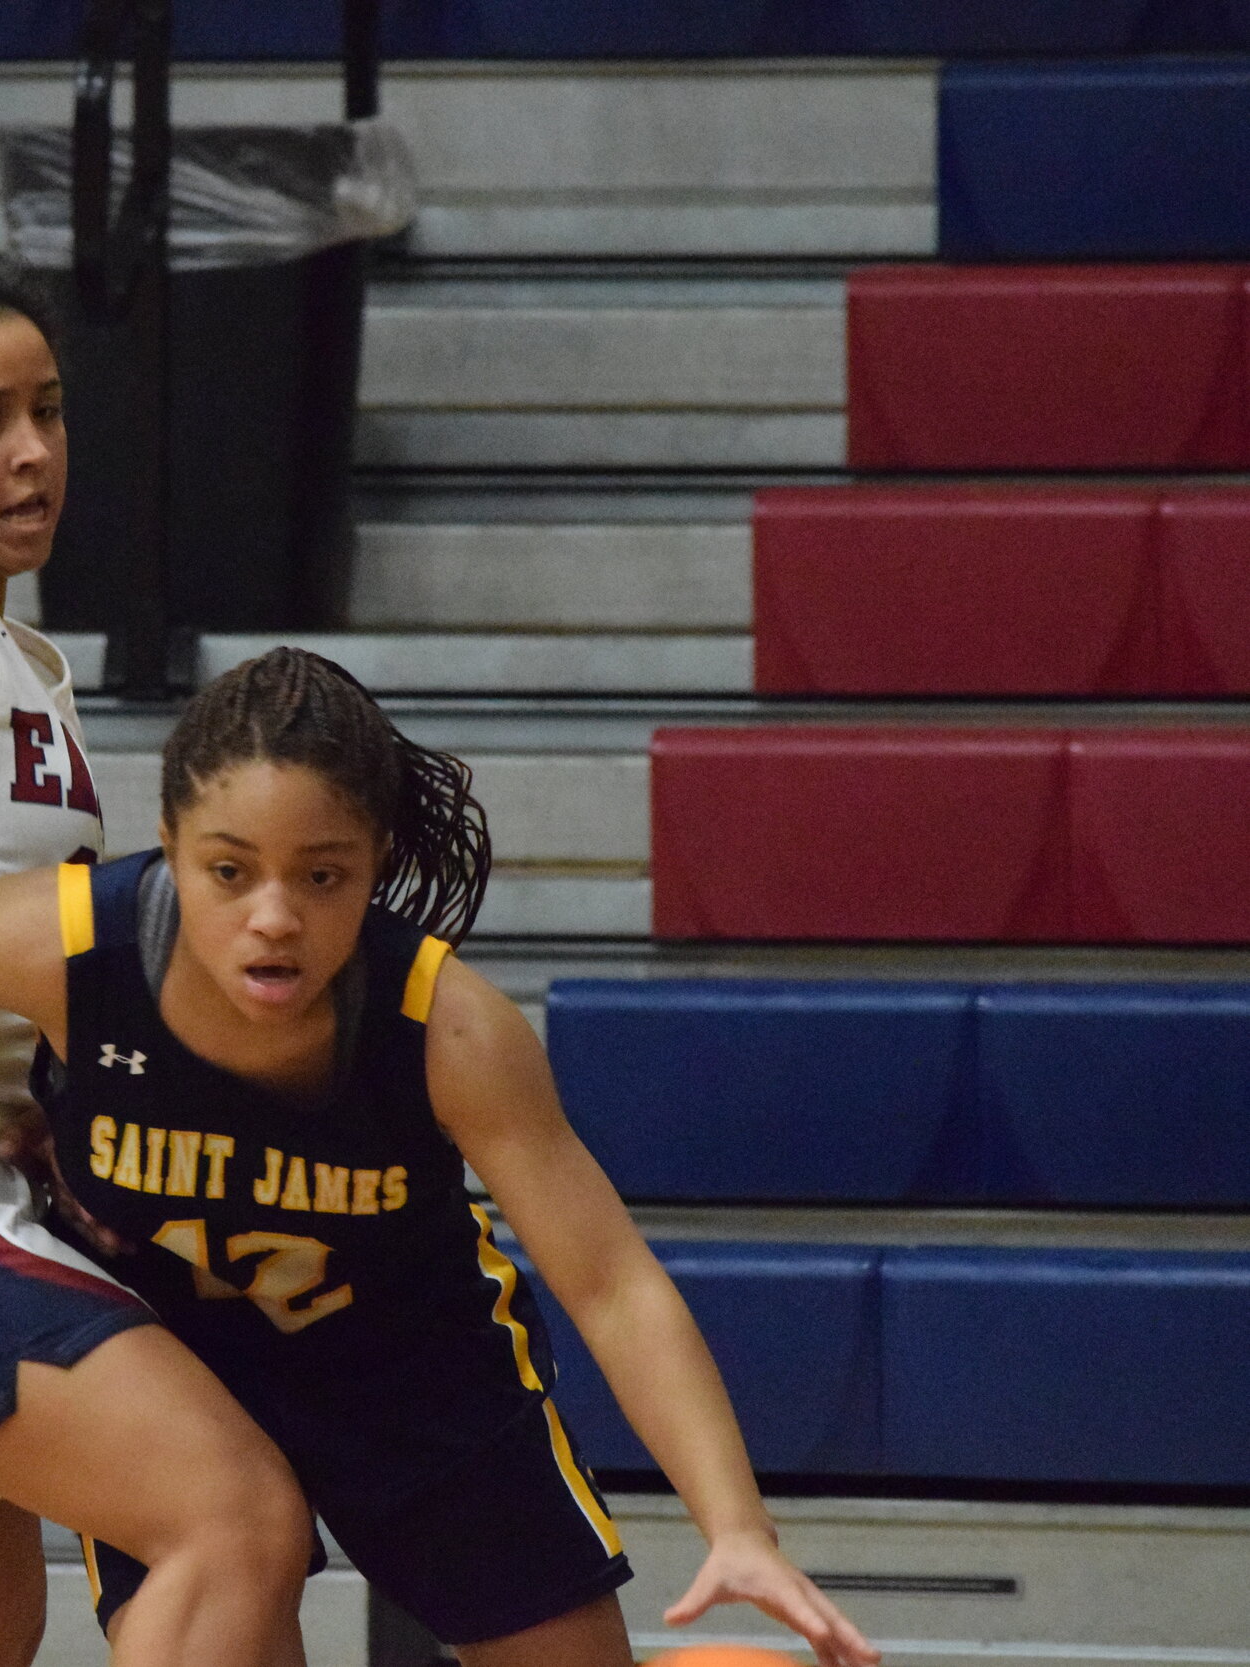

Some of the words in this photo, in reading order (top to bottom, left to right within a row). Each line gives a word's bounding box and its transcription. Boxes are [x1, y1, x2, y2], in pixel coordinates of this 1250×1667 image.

[90, 1115, 235, 1199] SAINT
[253, 1147, 408, 1215] JAMES
[151, 1218, 353, 1334] 12
